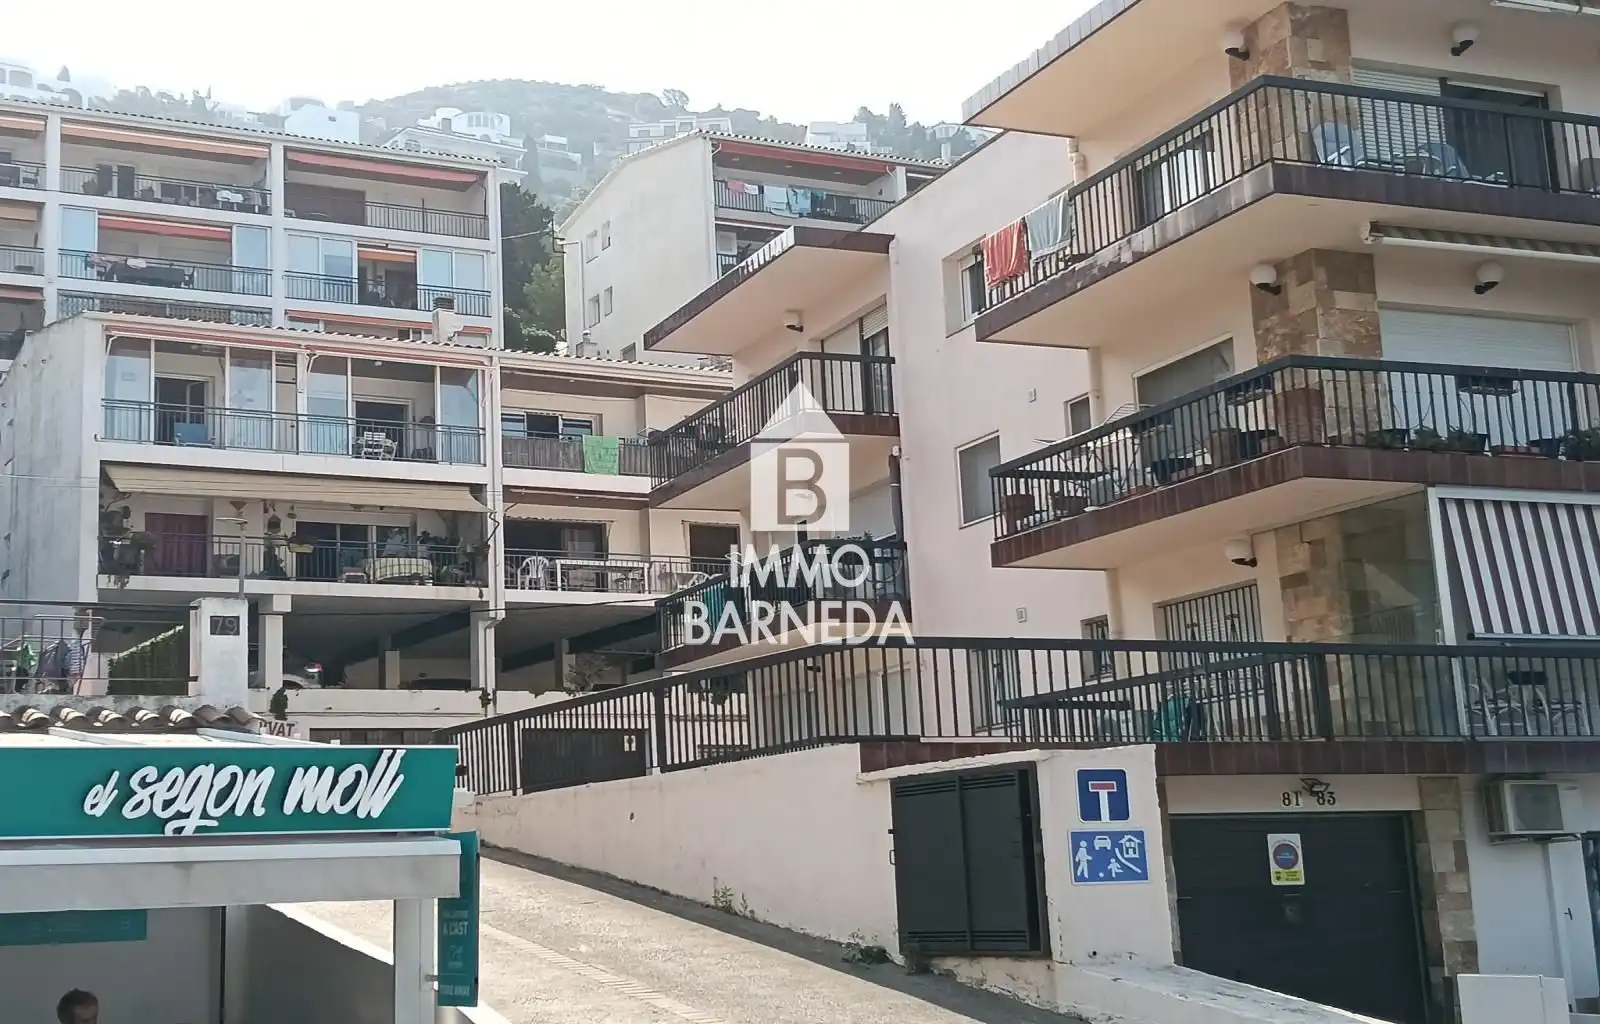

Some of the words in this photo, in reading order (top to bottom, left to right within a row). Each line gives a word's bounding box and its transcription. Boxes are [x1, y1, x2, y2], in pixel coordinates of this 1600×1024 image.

[211, 616, 238, 635] 79
[84, 770, 119, 817] el
[121, 763, 275, 835] segon
[282, 749, 407, 818] moll
[1316, 790, 1336, 806] 83
